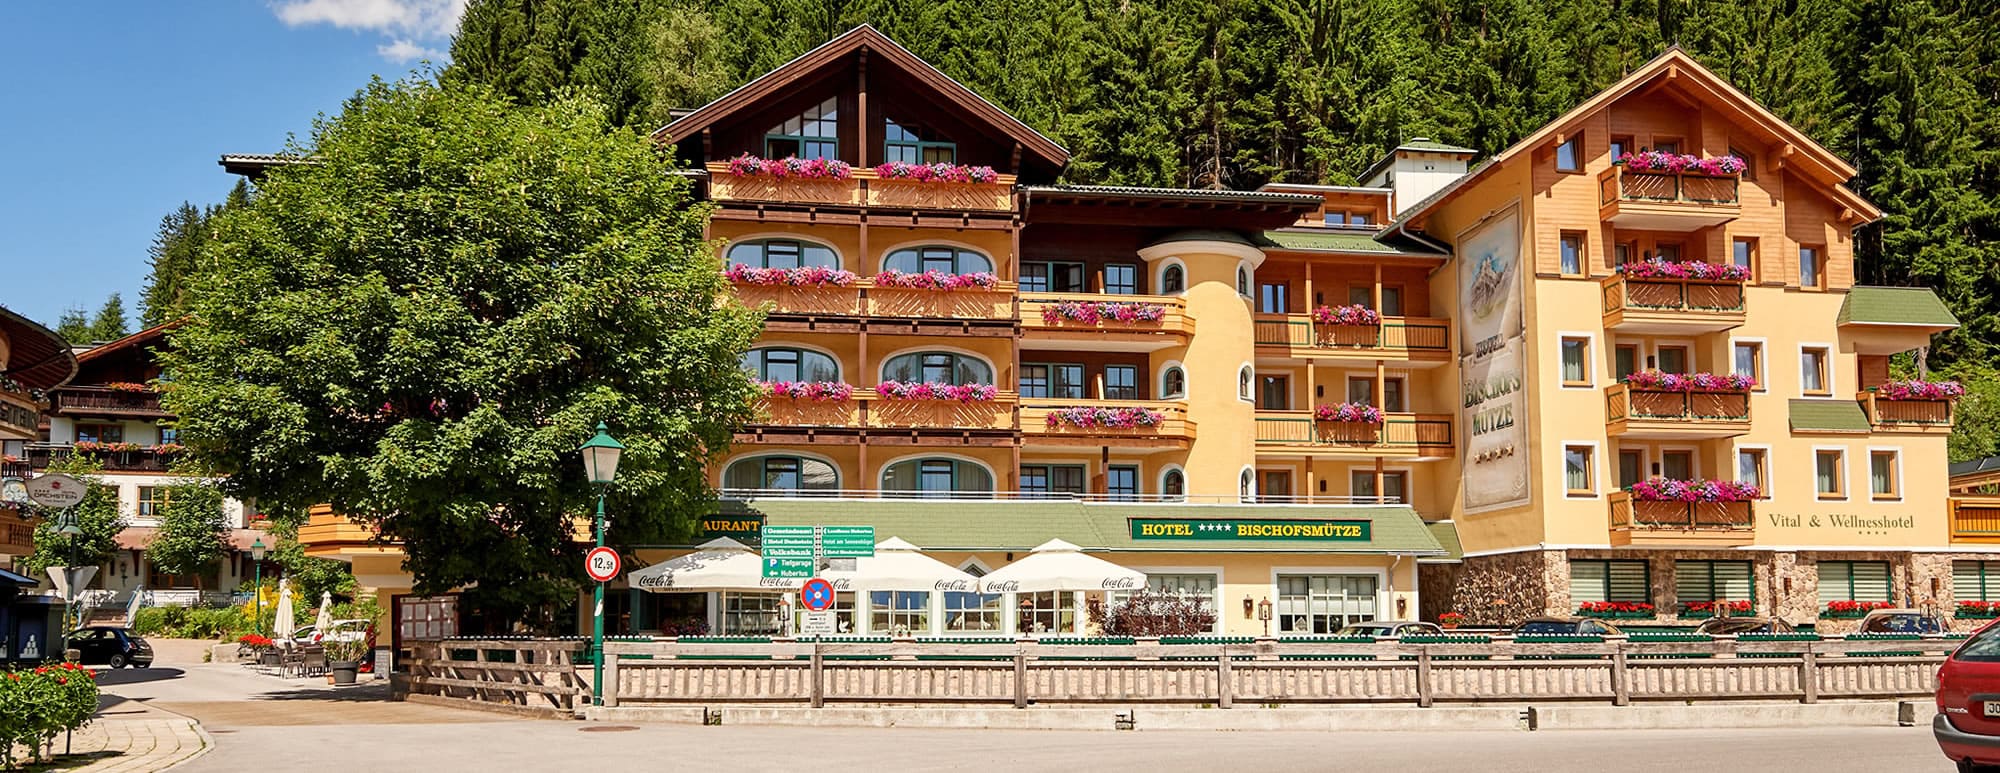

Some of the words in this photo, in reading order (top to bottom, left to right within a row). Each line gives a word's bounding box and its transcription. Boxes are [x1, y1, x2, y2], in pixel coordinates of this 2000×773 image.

[1472, 404, 1514, 436] MÜTZE
[1769, 514, 1801, 527] Vital
[1808, 514, 1821, 527] &
[1829, 514, 1914, 528] Wellnesshotel
[1142, 524, 1193, 535] HOTEL
[1237, 523, 1362, 537] BISCHOFSMÜTZE
[781, 559, 812, 567] Tiefgarage
